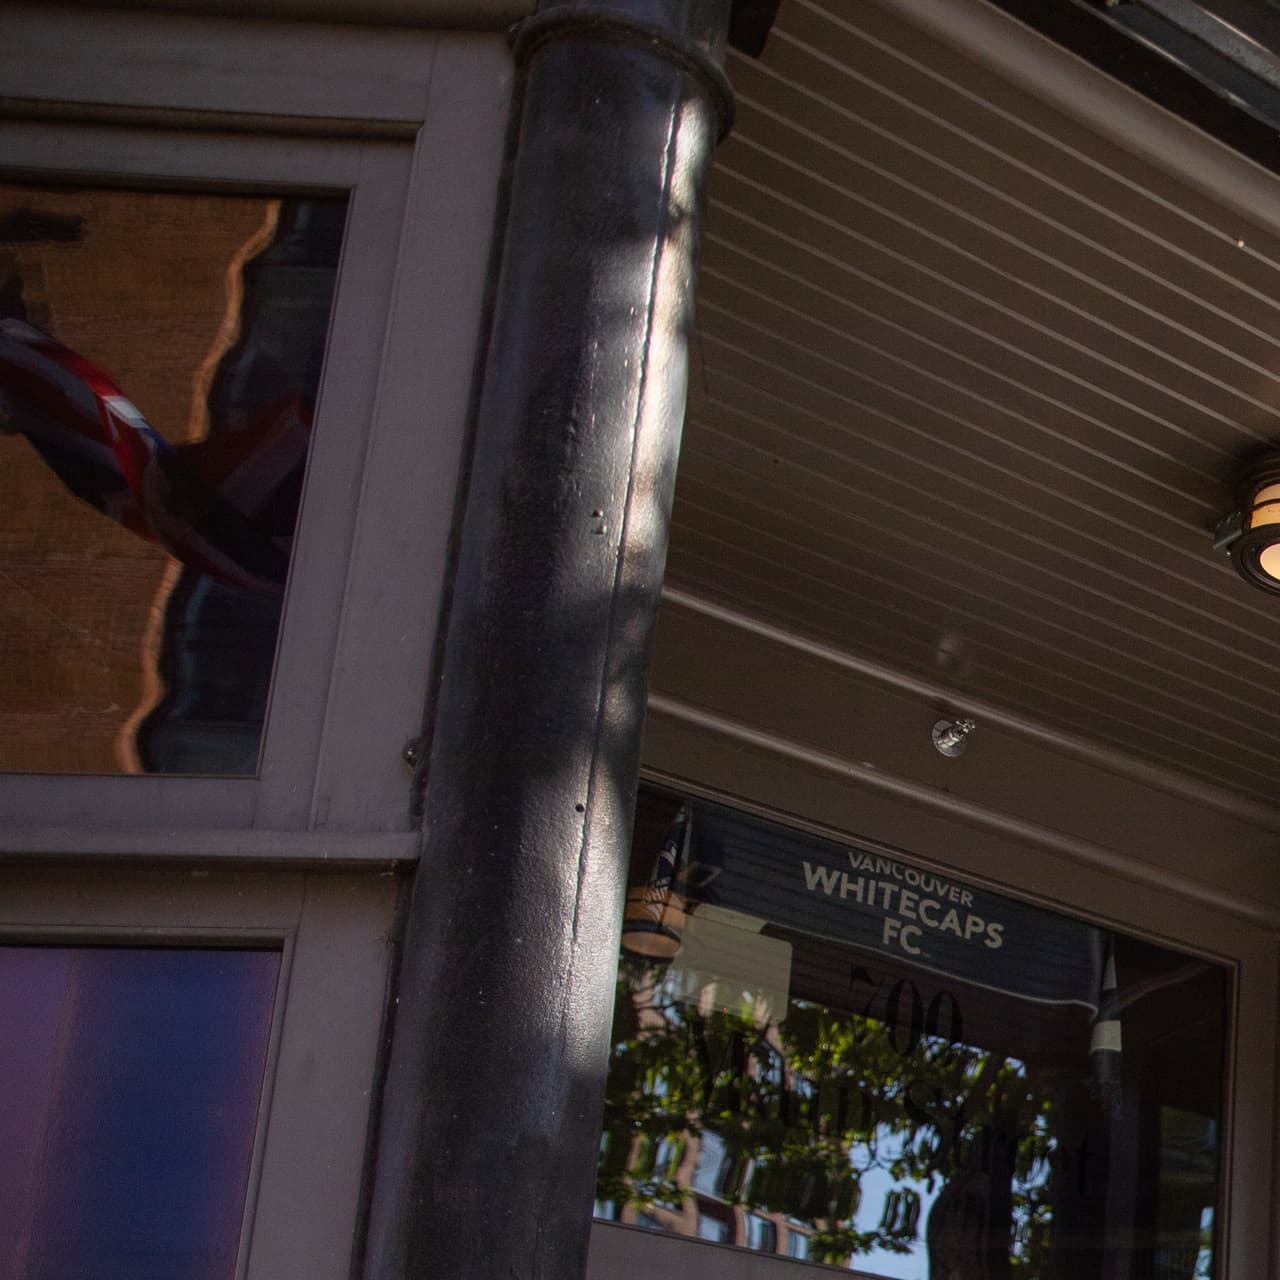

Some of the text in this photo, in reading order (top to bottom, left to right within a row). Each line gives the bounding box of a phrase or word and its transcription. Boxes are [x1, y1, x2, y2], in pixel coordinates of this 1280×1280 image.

[802, 861, 1004, 949] WHITECAPS
[848, 851, 974, 908] VANCOUVER
[882, 916, 923, 955] FC
[849, 966, 963, 1056] 700
